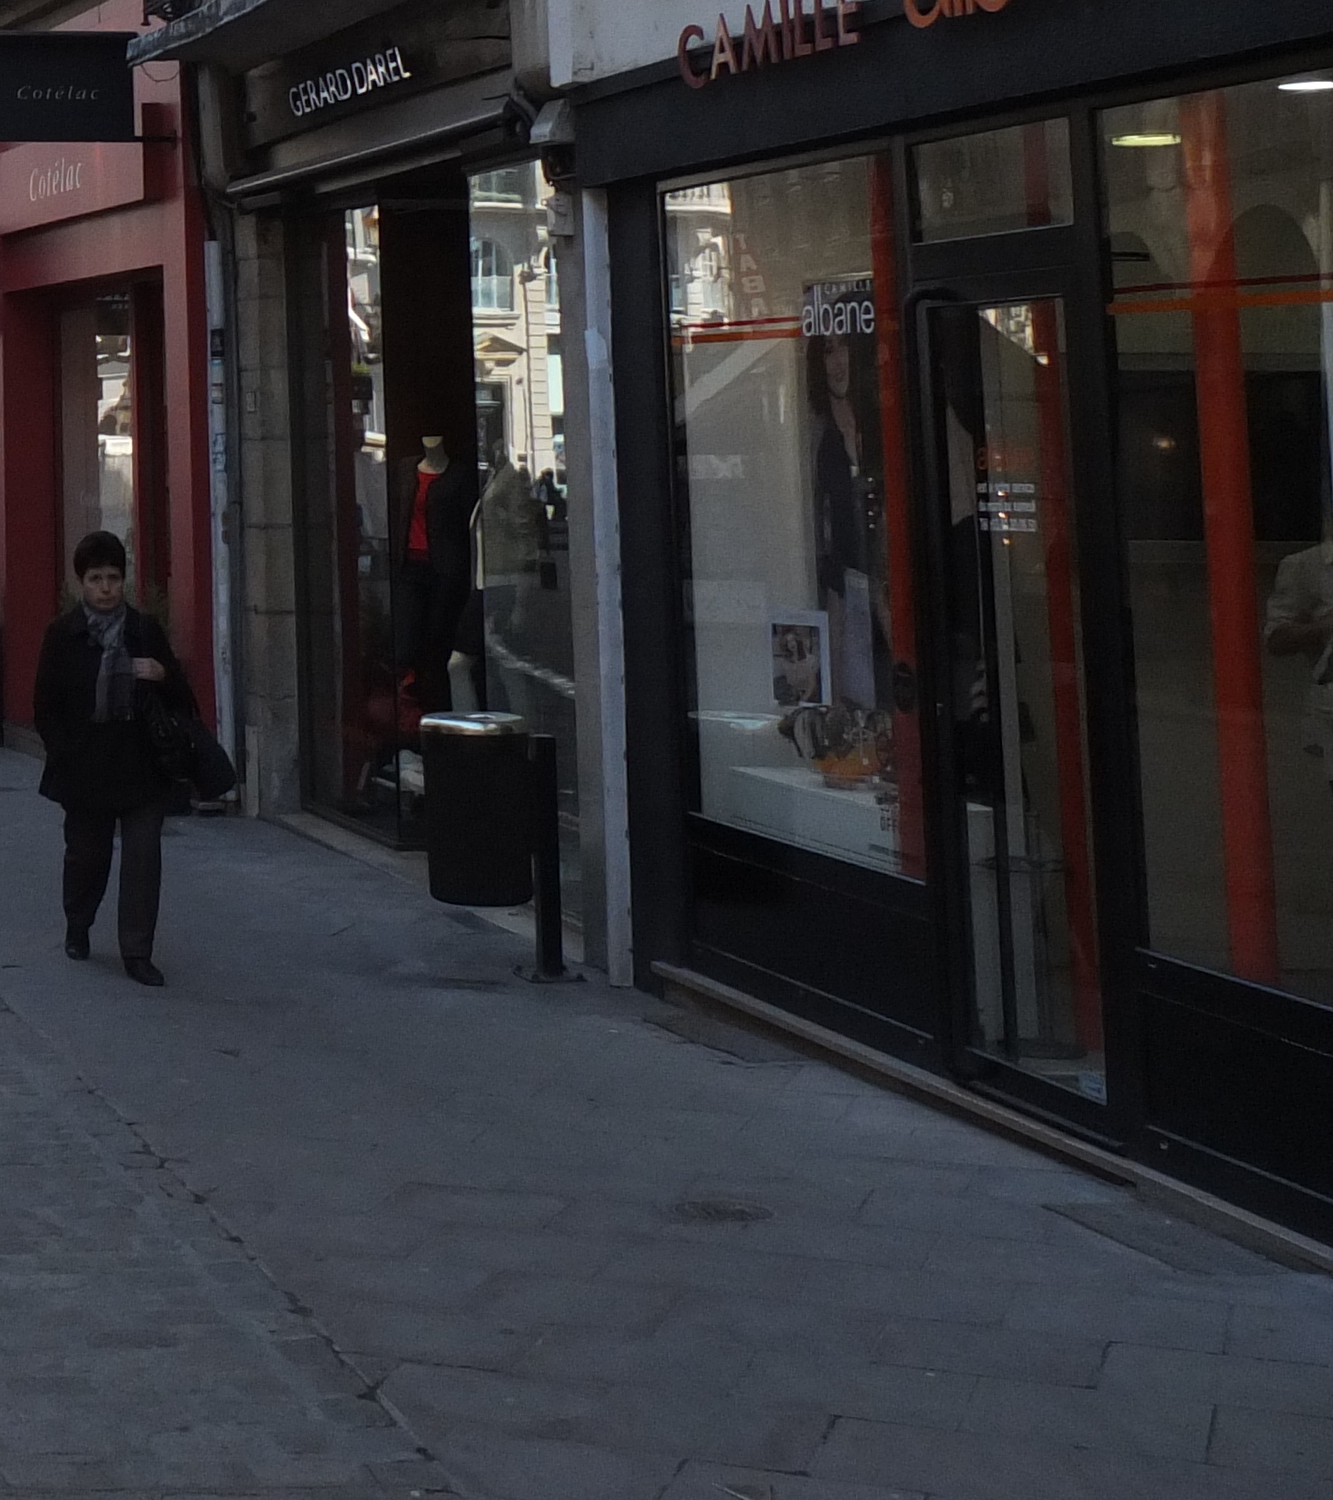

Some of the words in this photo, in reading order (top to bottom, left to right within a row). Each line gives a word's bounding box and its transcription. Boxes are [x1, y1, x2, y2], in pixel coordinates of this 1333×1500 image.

[17, 84, 100, 101] Cotélac
[289, 68, 352, 117] GERARD
[351, 46, 412, 95] DAREL
[29, 157, 82, 202] Cotélac
[801, 284, 875, 337] albane
